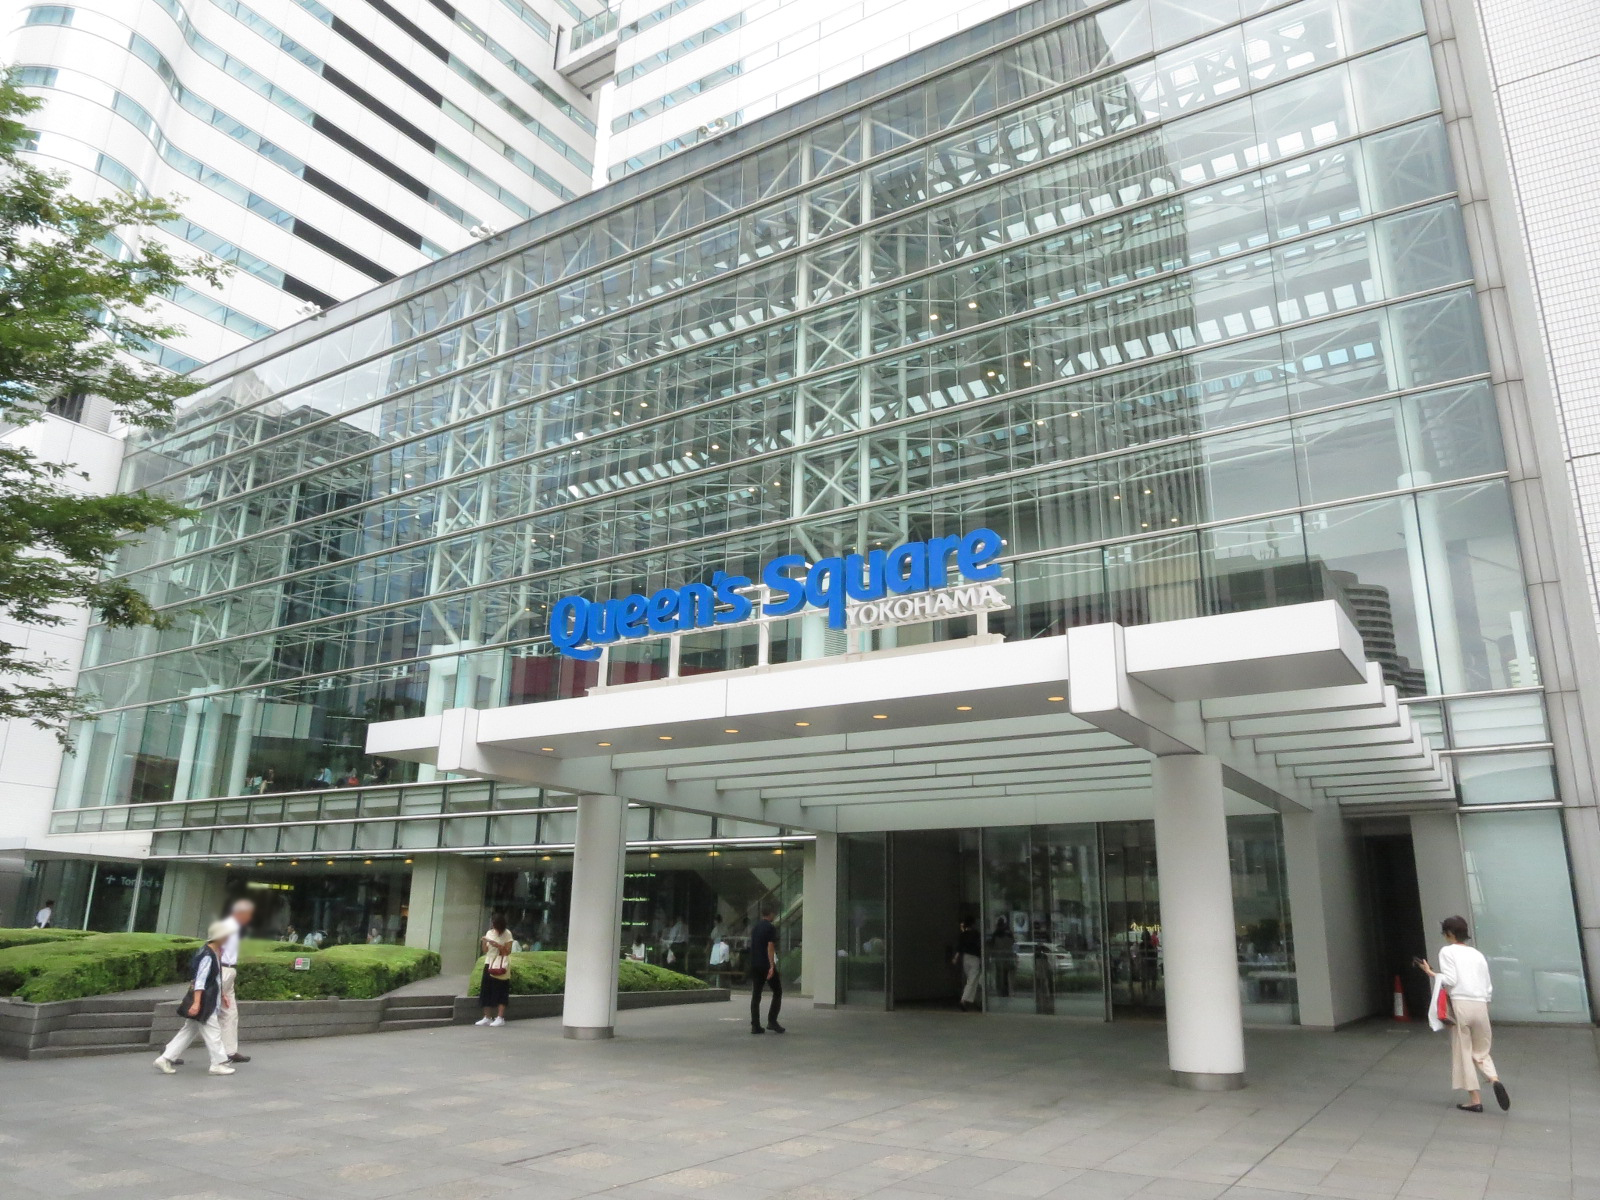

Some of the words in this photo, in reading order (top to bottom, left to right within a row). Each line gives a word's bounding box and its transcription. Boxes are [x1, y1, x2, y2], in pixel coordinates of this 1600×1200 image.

[549, 570, 752, 661] Queen's
[763, 528, 1002, 629] Square
[846, 585, 1000, 626] YOKOHAMA
